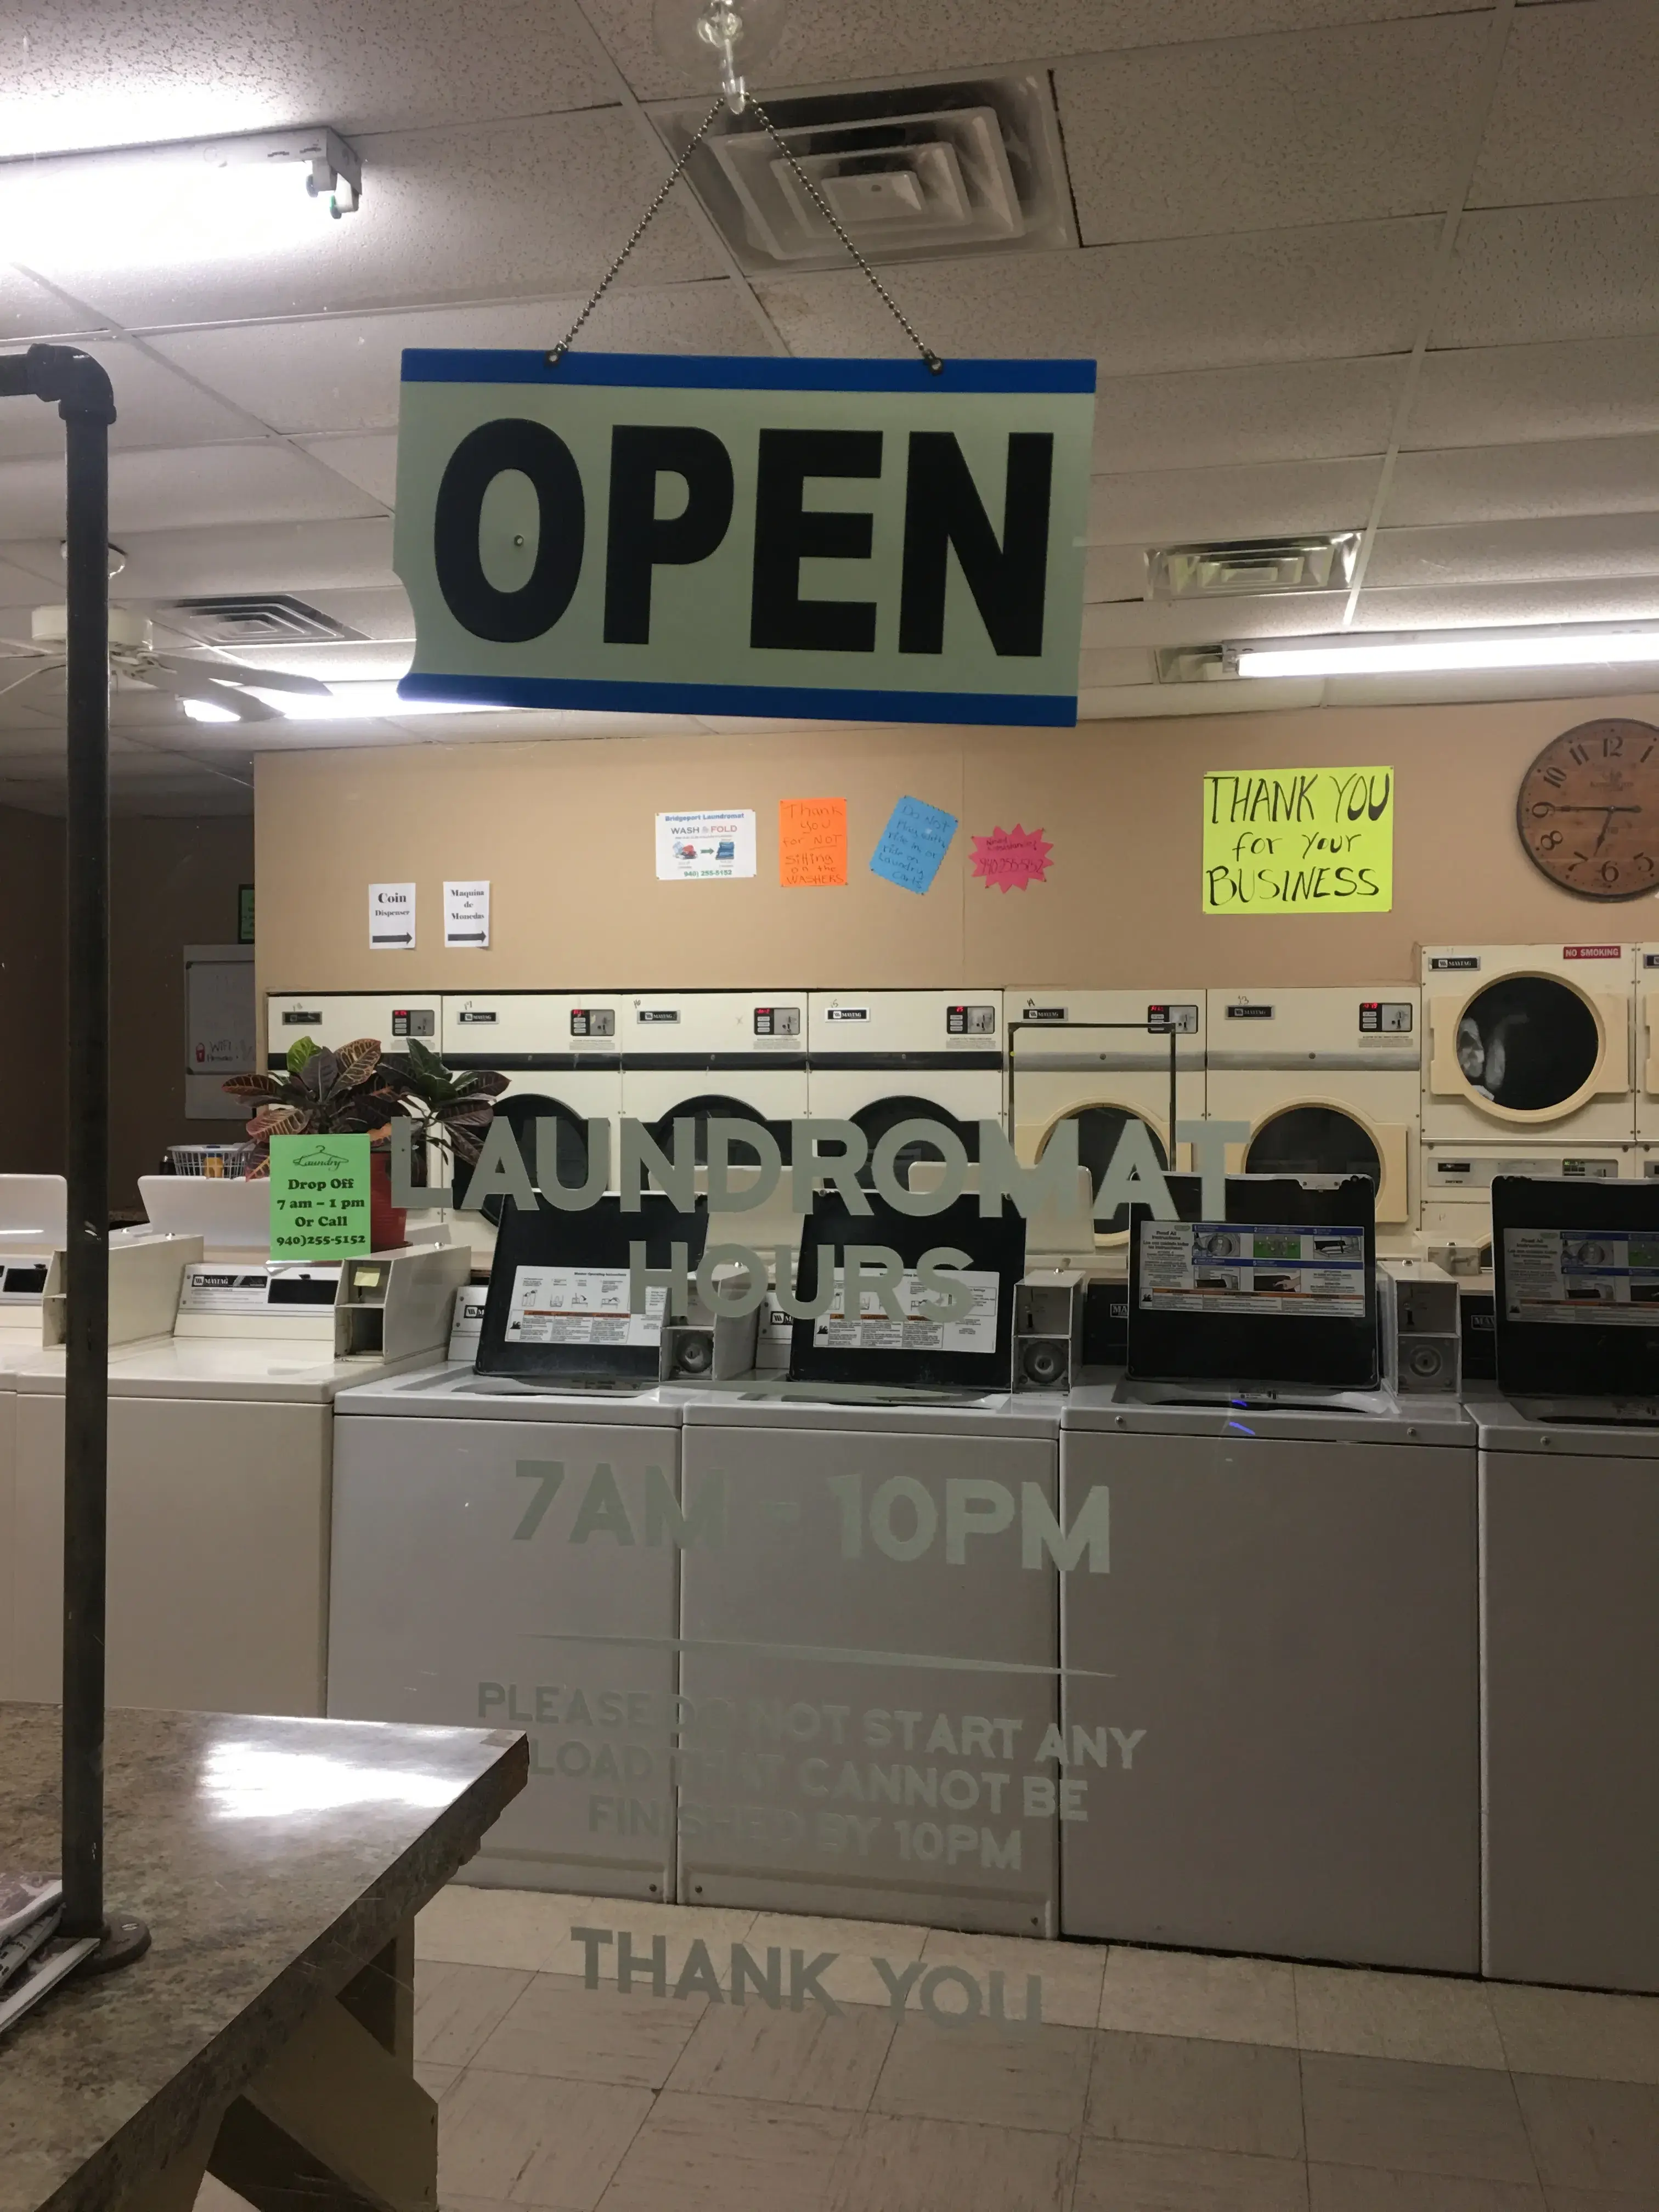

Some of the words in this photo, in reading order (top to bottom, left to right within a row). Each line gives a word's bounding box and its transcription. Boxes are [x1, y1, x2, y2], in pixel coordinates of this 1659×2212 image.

[435, 417, 1054, 657] OPEN
[1603, 736, 1623, 757] 12
[1544, 766, 1567, 788] 10
[1204, 774, 1318, 824] THANK
[1330, 773, 1390, 823] YOU
[1232, 832, 1283, 862] for
[1206, 865, 1379, 906] BUSINESS
[1601, 860, 1619, 883] 6
[378, 893, 407, 903] Coin
[1565, 949, 1577, 957] NO
[1581, 947, 1619, 957] SMOKING
[391, 1115, 1251, 1221] LAUNDROMAT
[287, 1179, 326, 1191] Drop
[330, 1178, 354, 1189] Off
[276, 1199, 286, 1210] 7
[290, 1200, 313, 1209] am
[329, 1199, 336, 1208] 1
[341, 1199, 365, 1210] pm
[295, 1216, 314, 1227] Or
[318, 1216, 347, 1227] Call
[276, 1235, 366, 1247] 940)255-5152
[205, 1276, 228, 1285] MAYTAG
[629, 1240, 974, 1324] HOURS
[512, 1459, 727, 1549] 7AM
[827, 1472, 1111, 1574] 10PM
[478, 1682, 648, 1730] PLEASE
[748, 1698, 850, 1745] NOT
[862, 1707, 1023, 1760] START
[1034, 1722, 1147, 1770] ANY
[531, 1737, 651, 1784] LOAD
[798, 1756, 1011, 1815] CANNOT
[1022, 1775, 1089, 1822] BE
[589, 1793, 807, 1847] FINISHED
[817, 1812, 883, 1857] BY
[893, 1818, 1023, 1872] 10PM
[571, 1926, 846, 2019] THANK
[871, 1956, 1043, 2034] YOU
